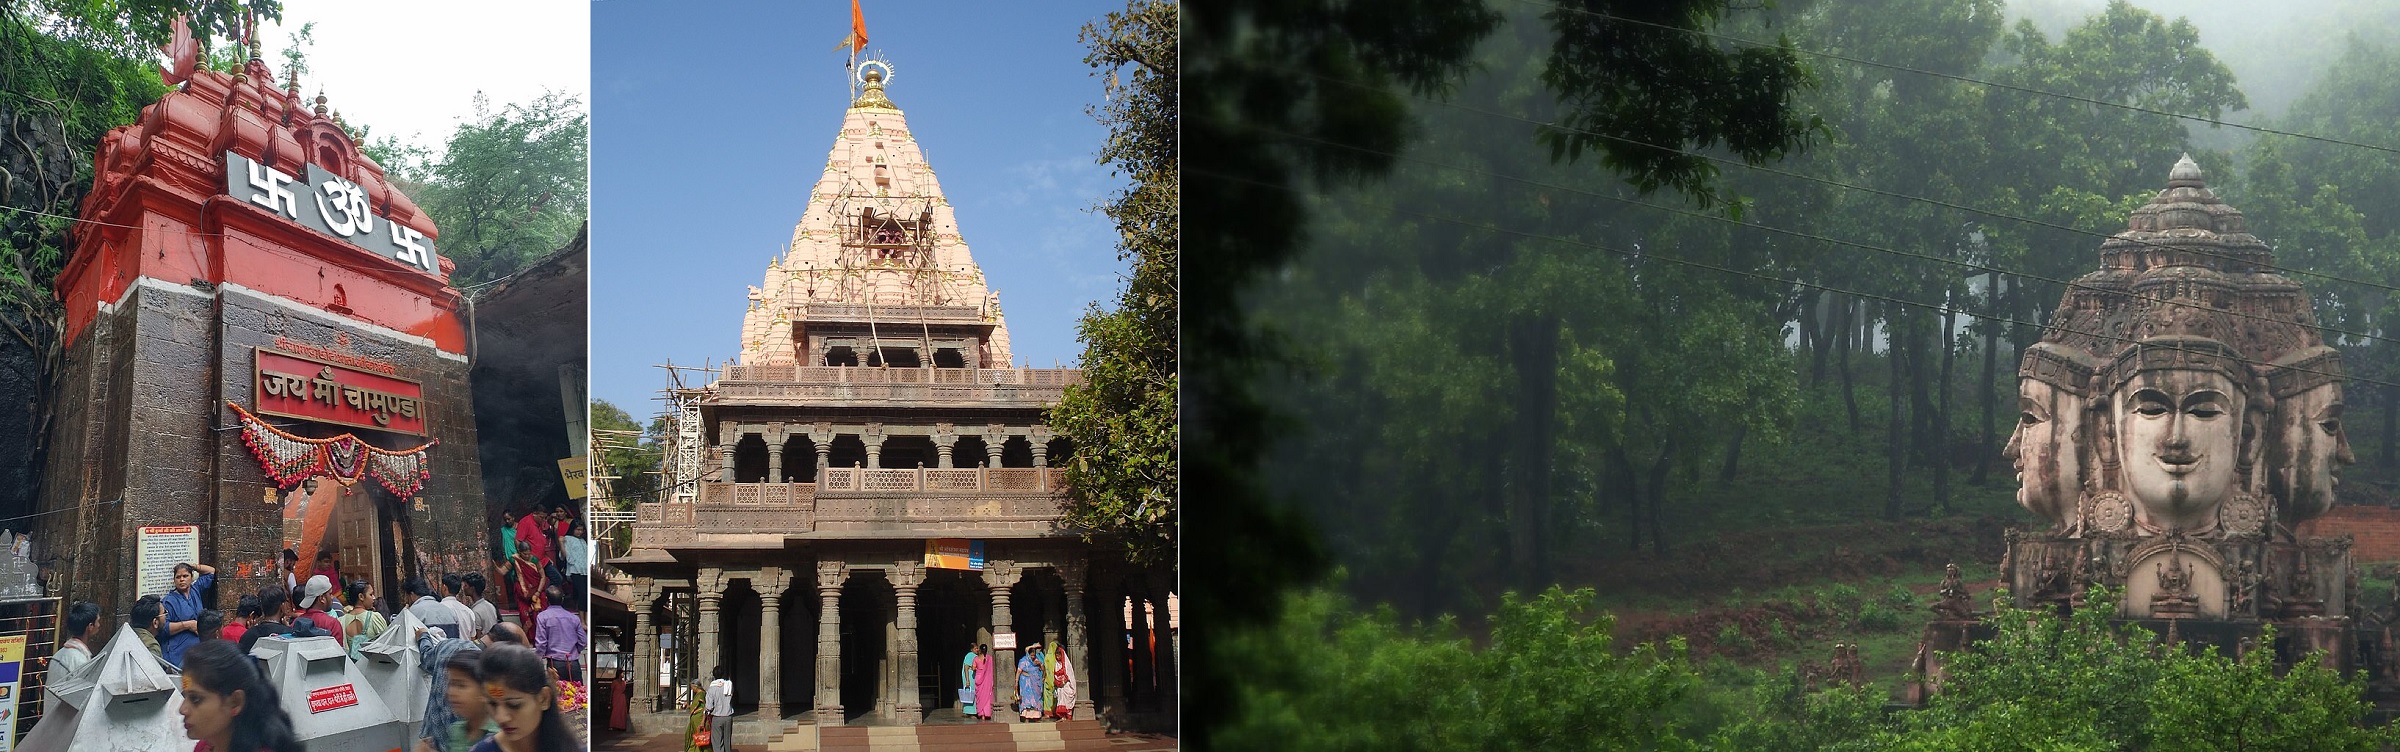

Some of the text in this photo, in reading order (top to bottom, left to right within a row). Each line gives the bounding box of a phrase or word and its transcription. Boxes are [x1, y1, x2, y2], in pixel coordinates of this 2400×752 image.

[262, 365, 422, 427] जय माँ चामुण्डा
